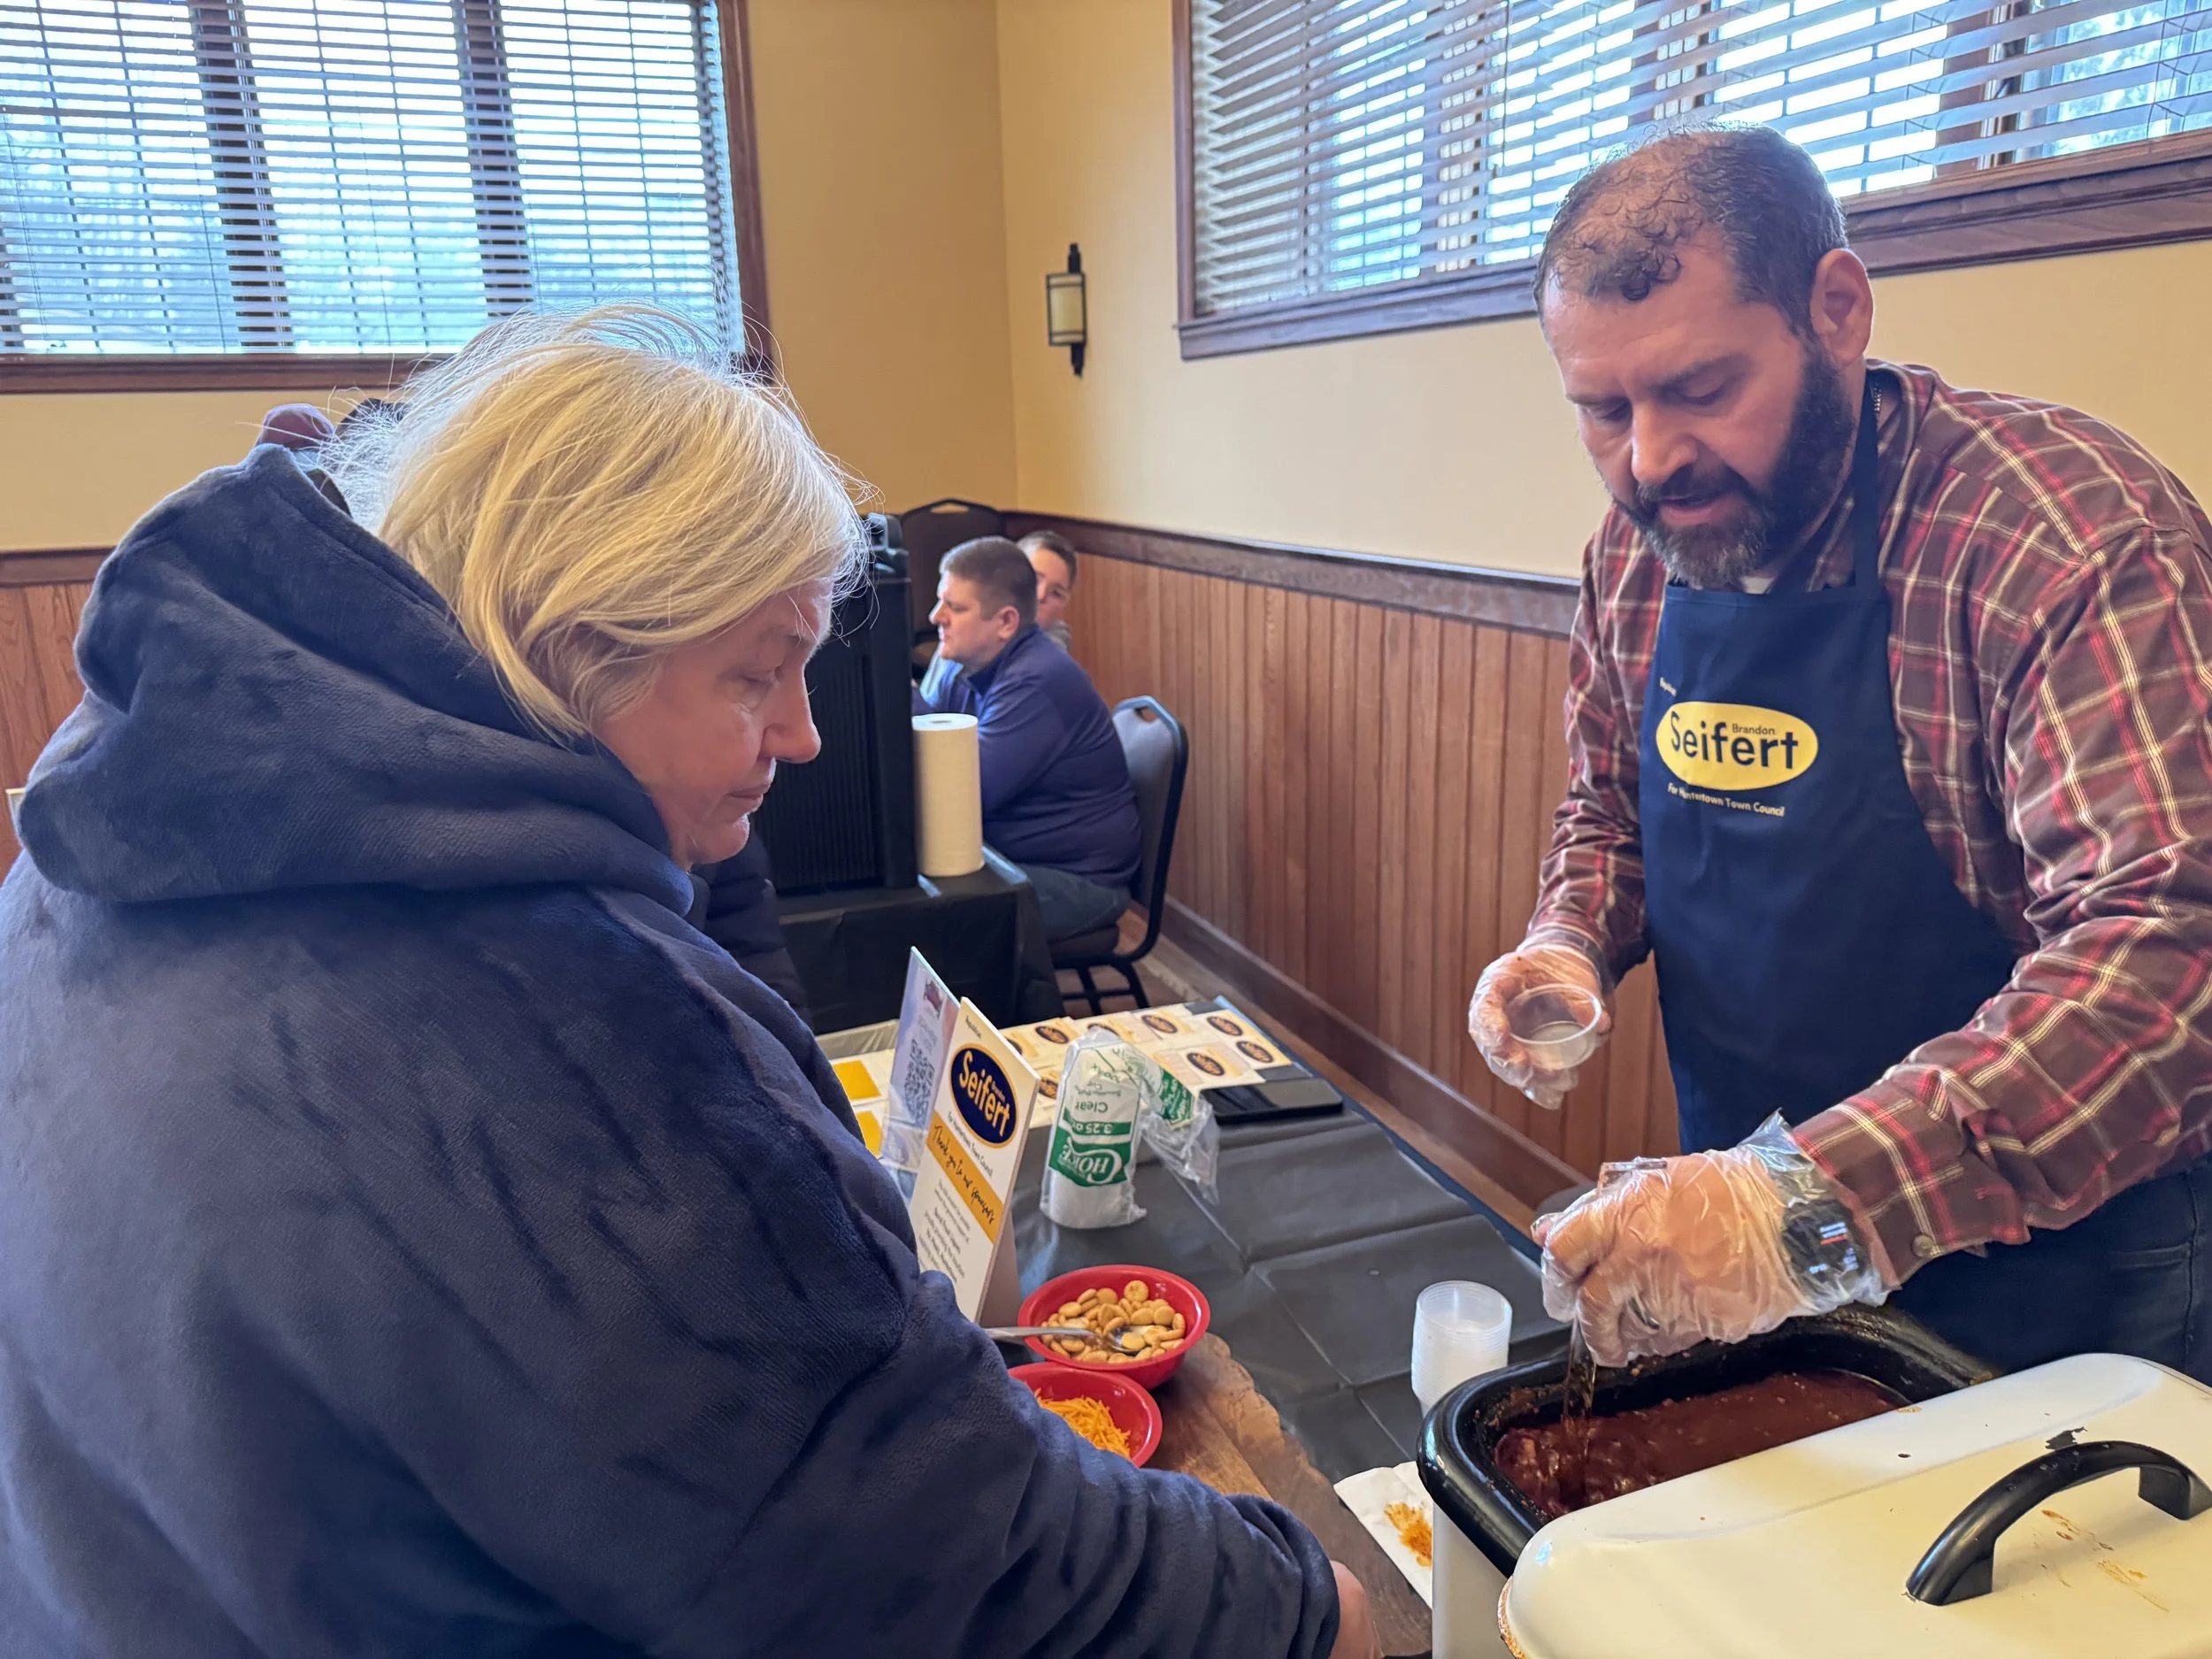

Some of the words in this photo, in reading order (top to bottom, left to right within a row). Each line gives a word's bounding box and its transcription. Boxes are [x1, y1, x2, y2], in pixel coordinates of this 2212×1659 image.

[1671, 710, 1799, 769] Seifert
[1732, 723, 1776, 735] Brandon
[1668, 782, 1678, 795] For
[1725, 798, 1751, 810] Town
[1753, 802, 1785, 818] Council
[959, 1050, 1010, 1138] Seifert
[1075, 1101, 1109, 1114] Clear
[1086, 1123, 1112, 1134] 3.25
